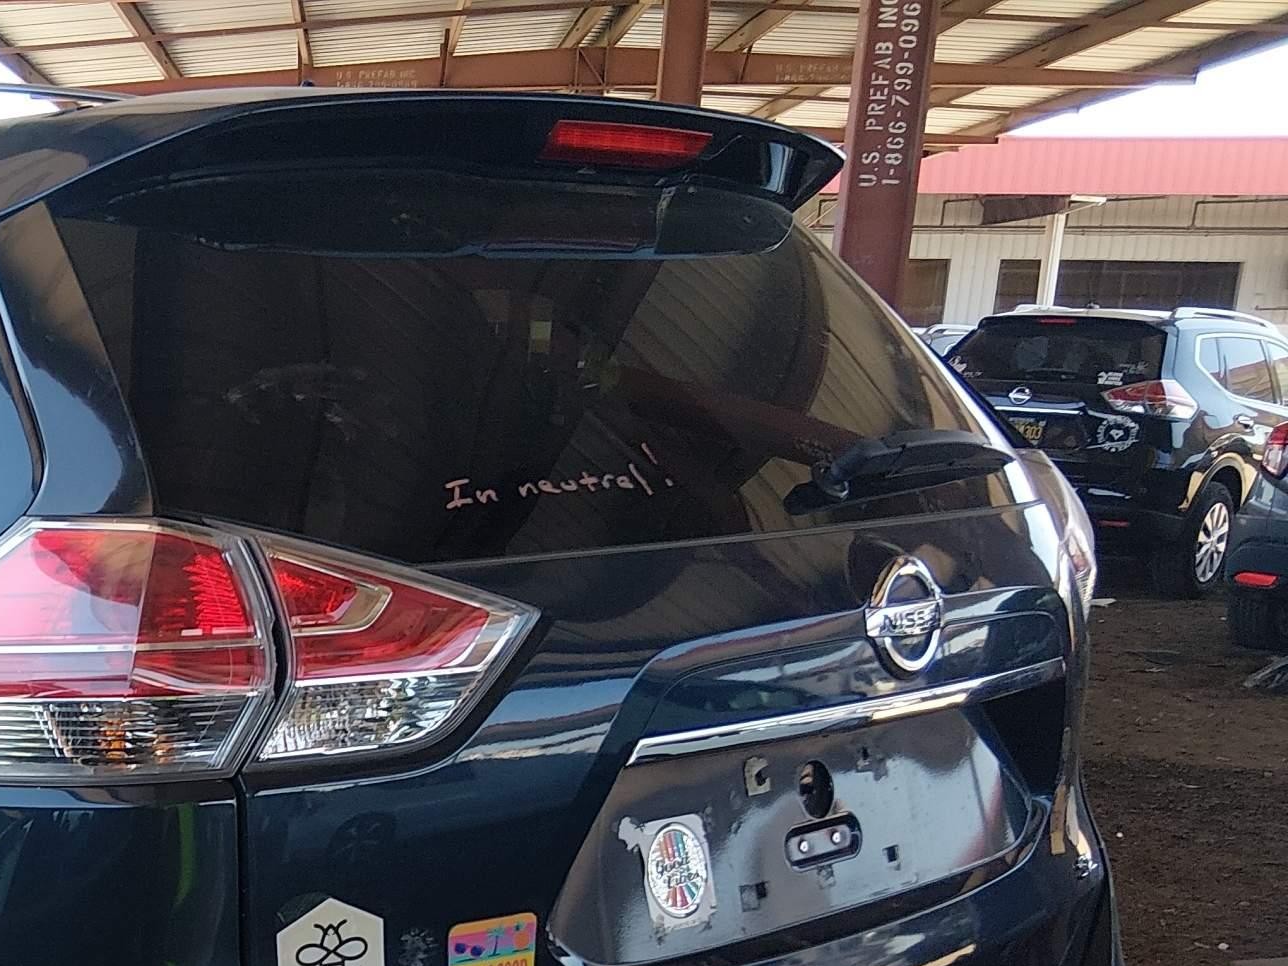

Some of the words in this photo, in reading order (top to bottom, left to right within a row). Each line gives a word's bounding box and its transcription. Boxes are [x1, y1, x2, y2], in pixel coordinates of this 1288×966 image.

[865, 41, 893, 131] PREFAB
[880, 2, 921, 186] 1-866-799-096
[858, 144, 882, 187] U.S.
[443, 477, 499, 510] In
